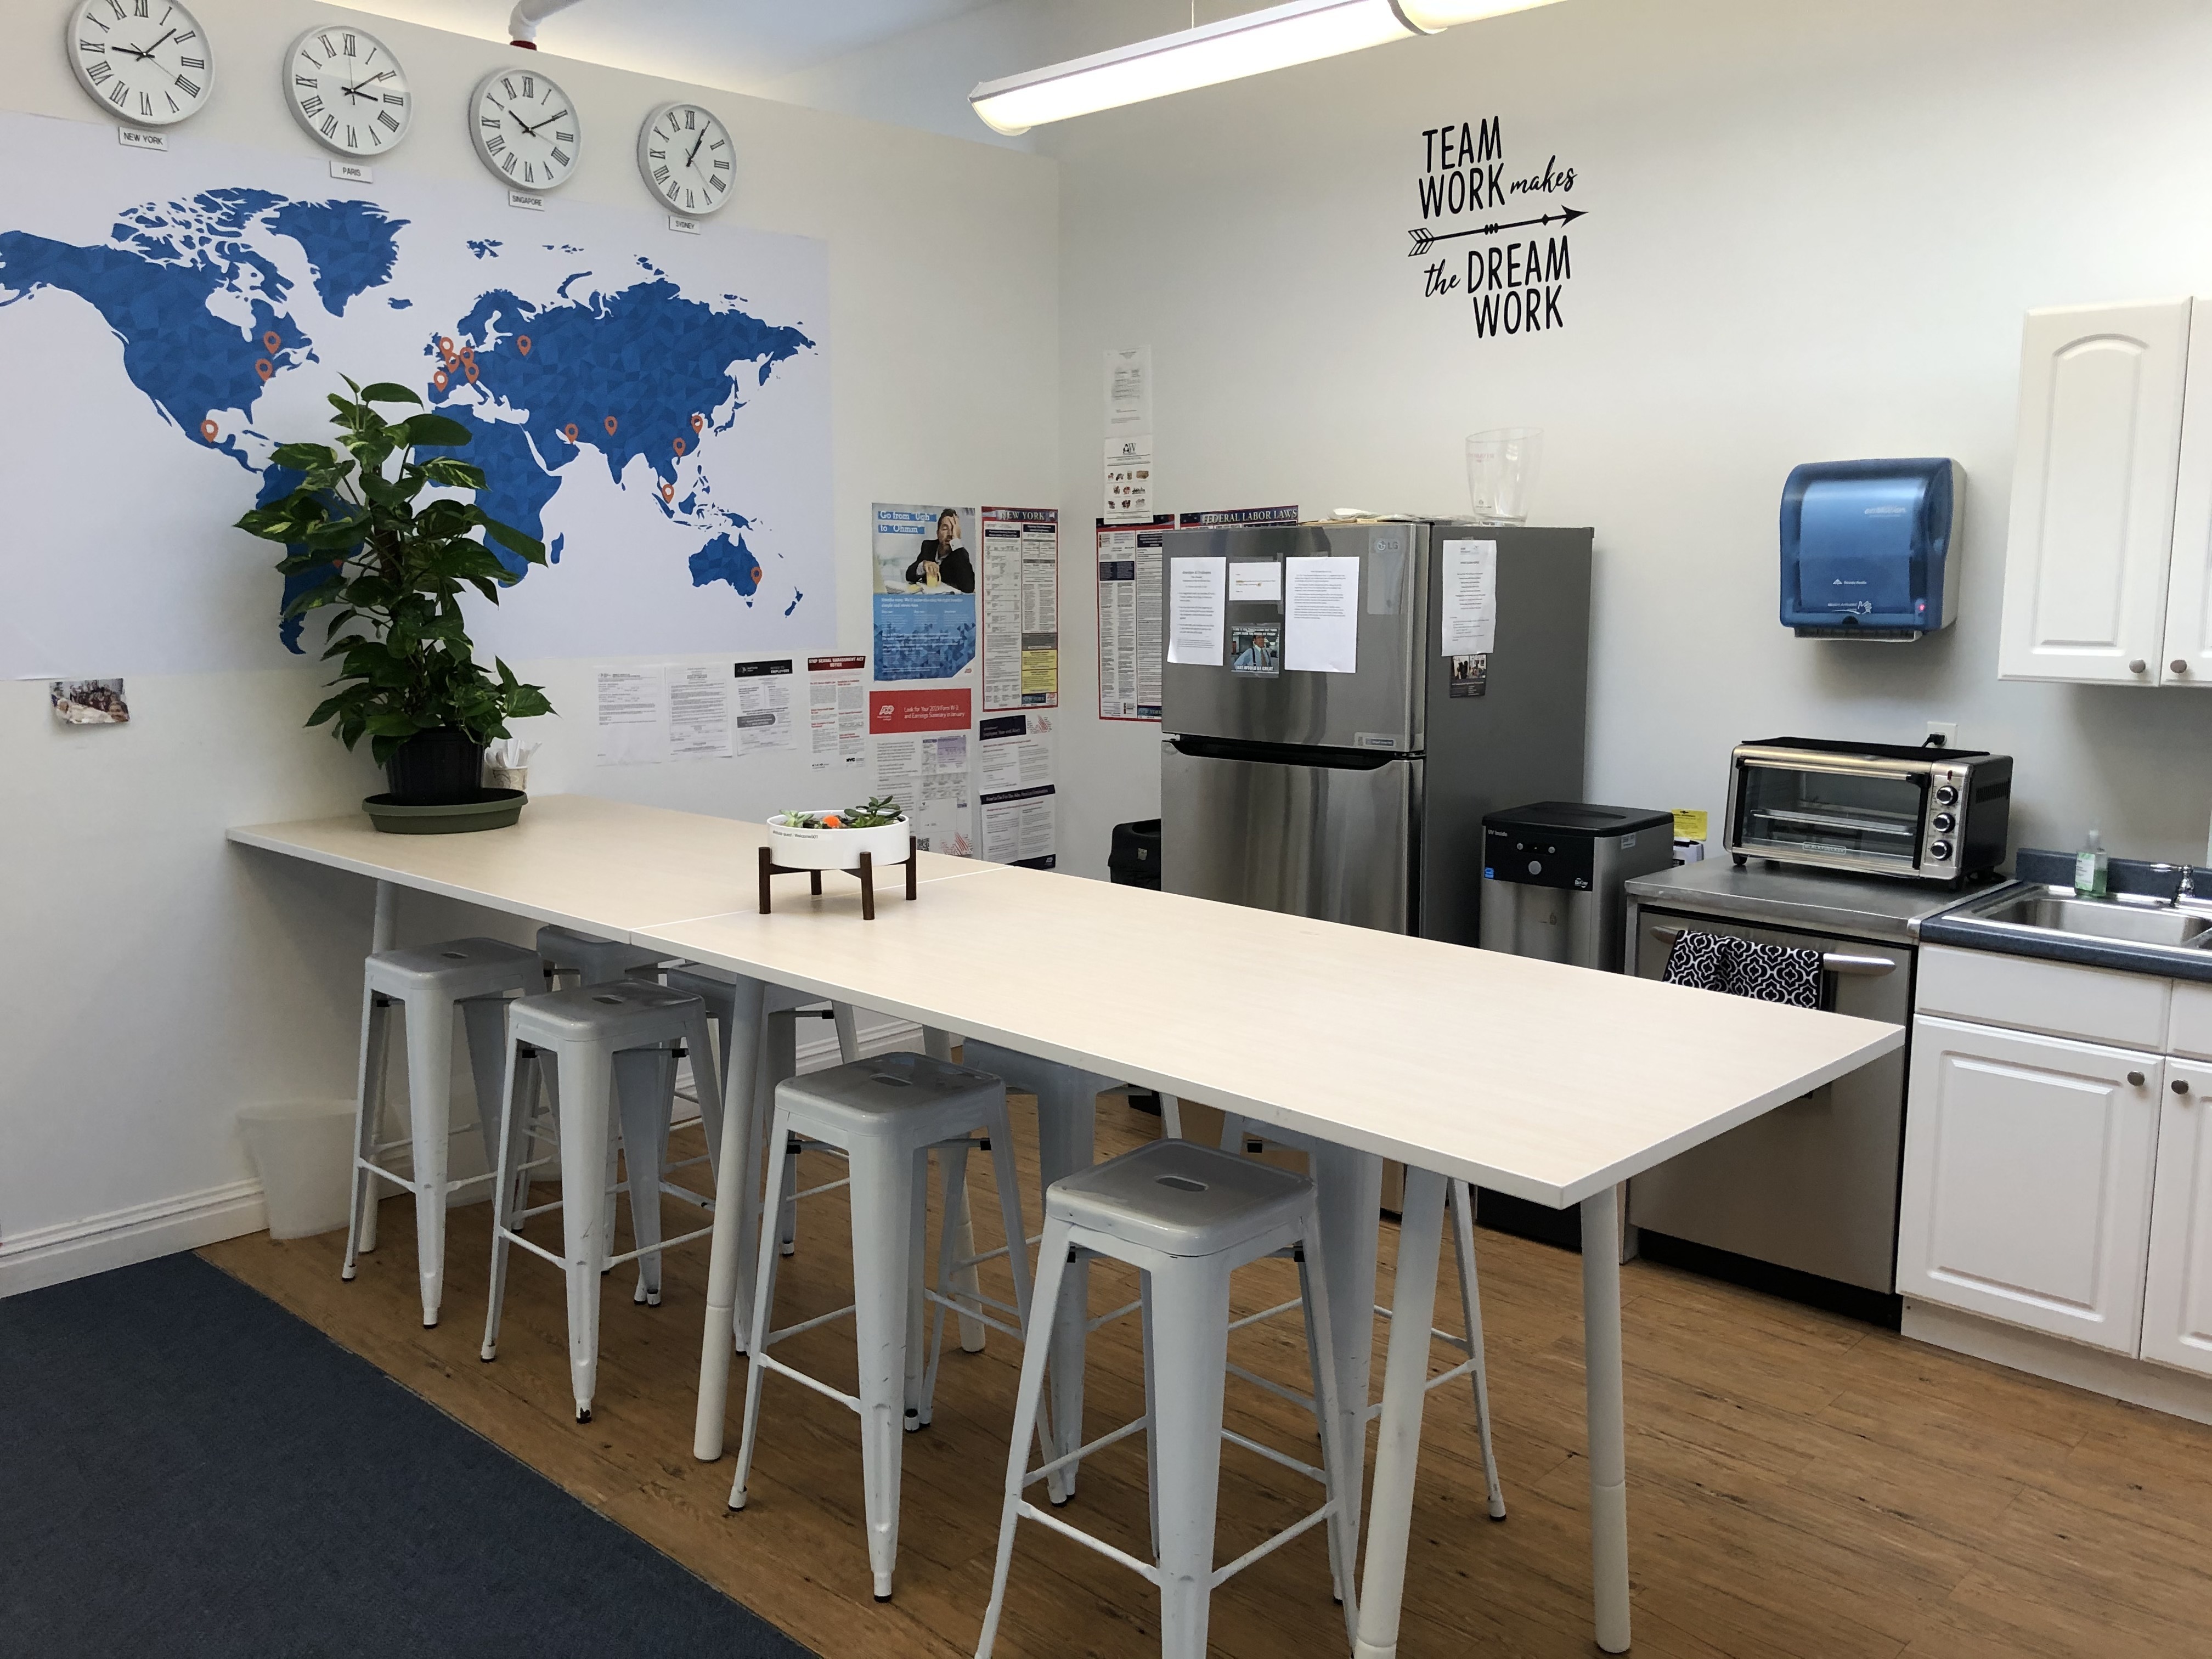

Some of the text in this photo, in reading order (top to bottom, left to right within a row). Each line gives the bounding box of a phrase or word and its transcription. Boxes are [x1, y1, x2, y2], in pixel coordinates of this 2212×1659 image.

[123, 132, 163, 145] NEW YORK
[1422, 115, 1502, 173] TEAM
[342, 167, 361, 176] PARIS
[1419, 155, 1578, 219] WORK makes
[512, 195, 542, 206] SINGAPORE
[675, 220, 695, 229] SYDNEY
[1424, 235, 1571, 297] the DREAM
[1472, 284, 1563, 338] WORK
[880, 511, 891, 519] Go
[893, 511, 910, 520] from
[1001, 511, 1045, 520] NEW YORK
[1203, 509, 1297, 524] FEDERAL LABOR LAWS
[879, 706, 894, 715] ADP
